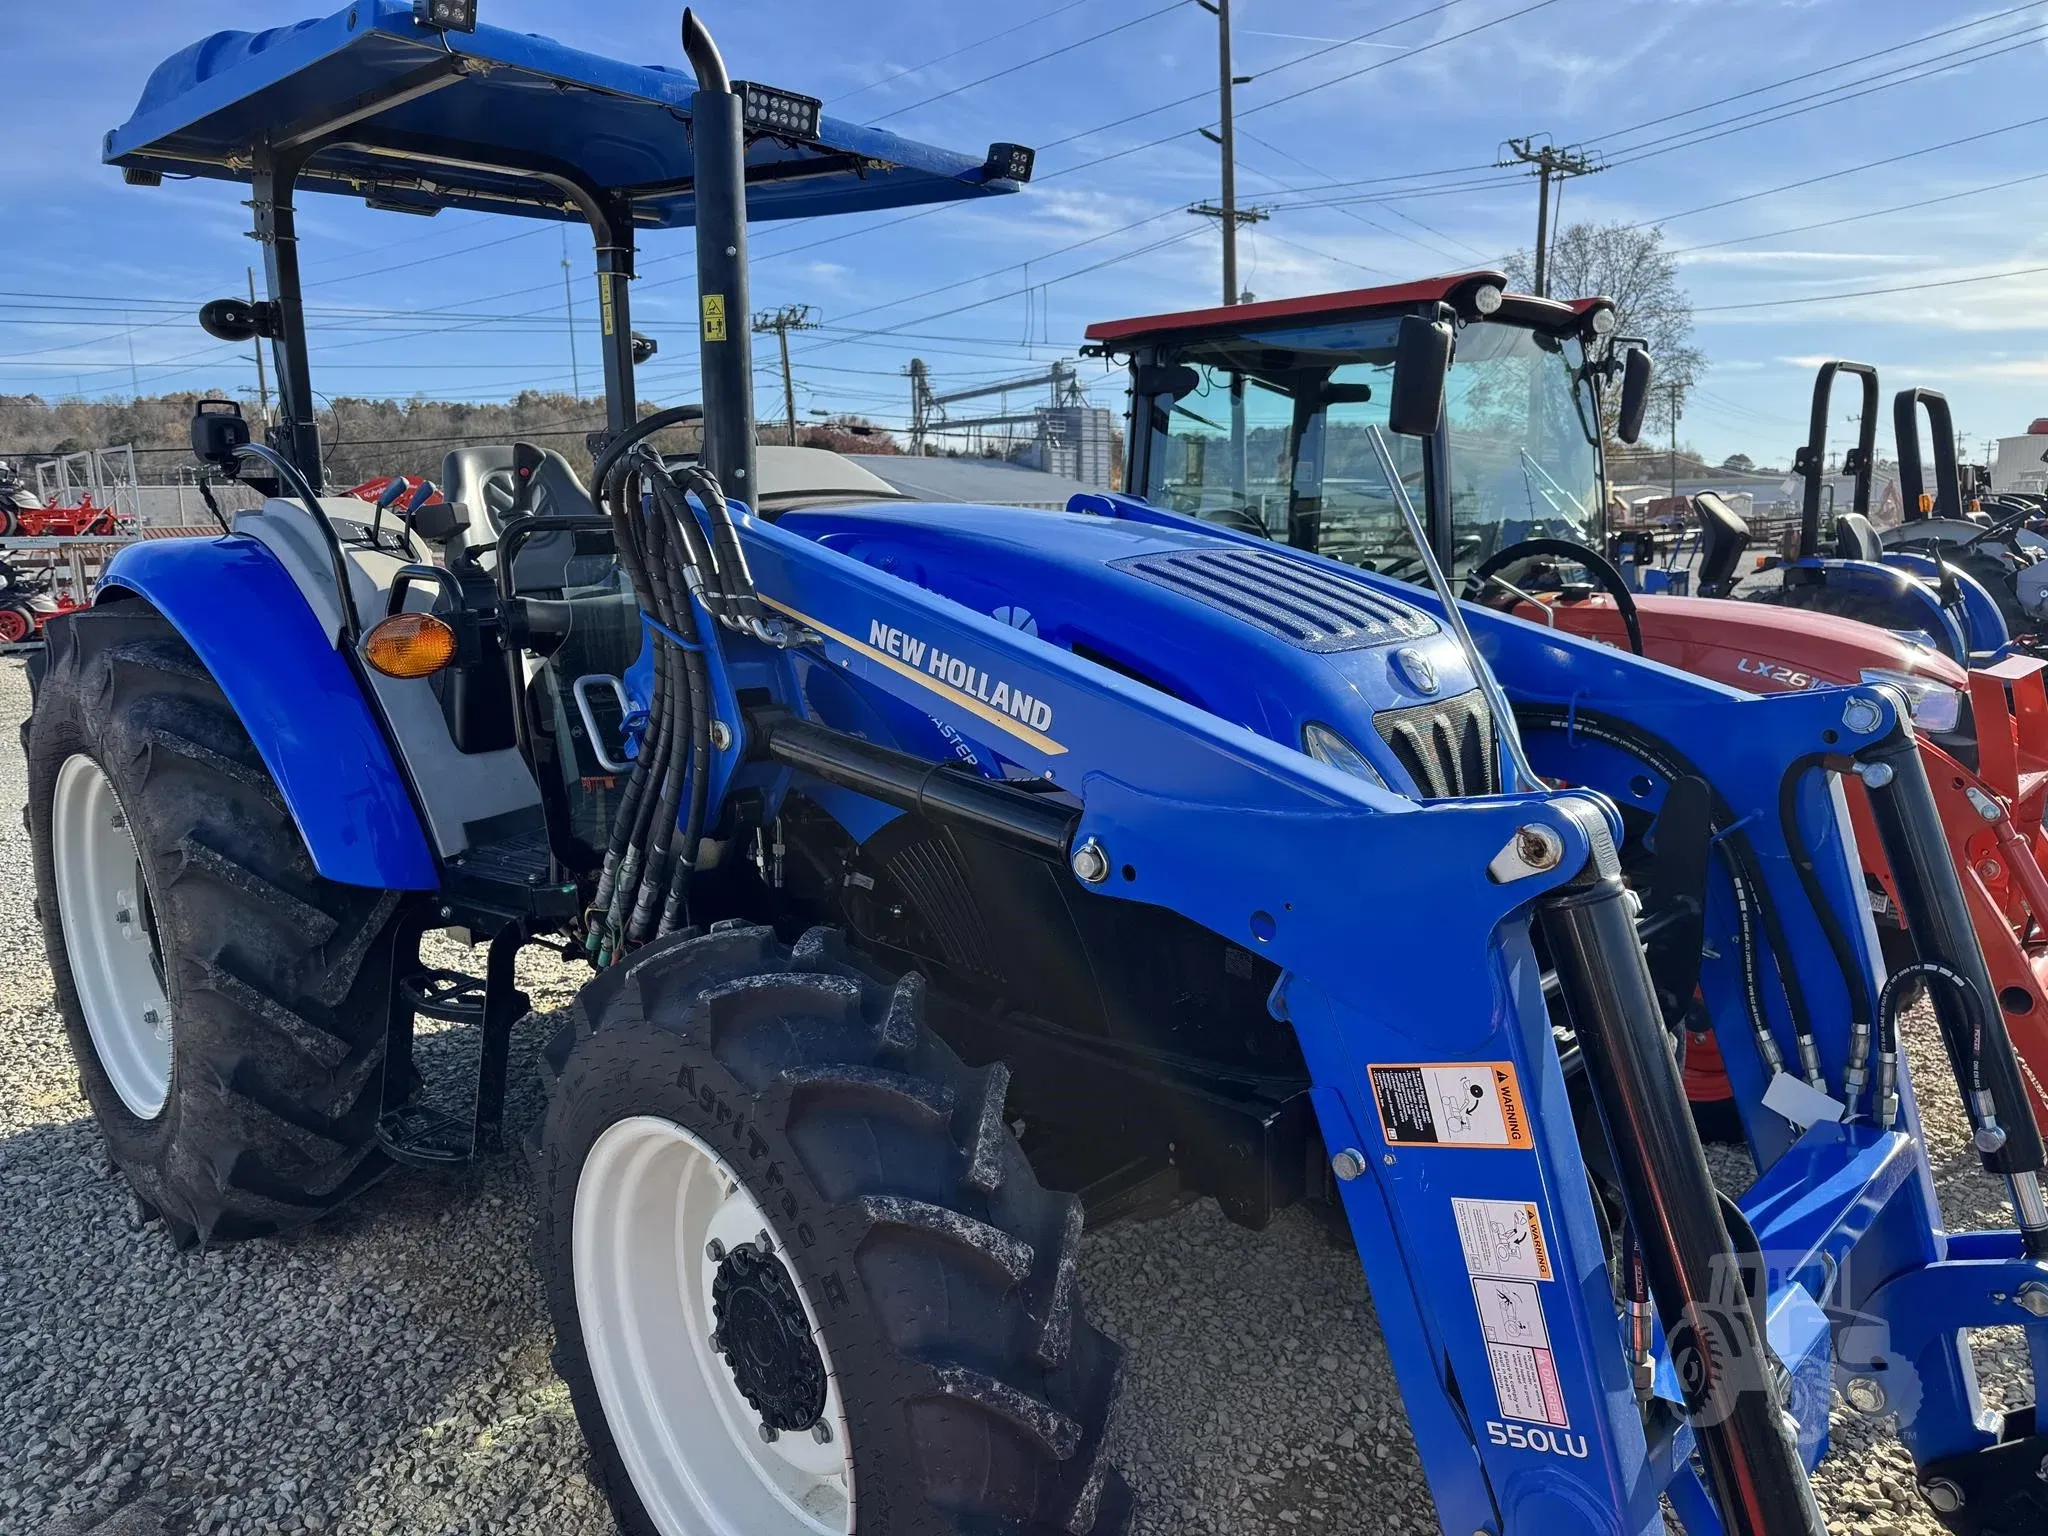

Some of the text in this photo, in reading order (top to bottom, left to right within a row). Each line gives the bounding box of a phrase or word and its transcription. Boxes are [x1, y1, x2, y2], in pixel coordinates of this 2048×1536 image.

[869, 619, 1052, 732] NEW HOLLAND
[1500, 1086, 1522, 1140] WARNING
[1530, 1224, 1547, 1273] WARNING
[1486, 1421, 1588, 1458] 550LU
